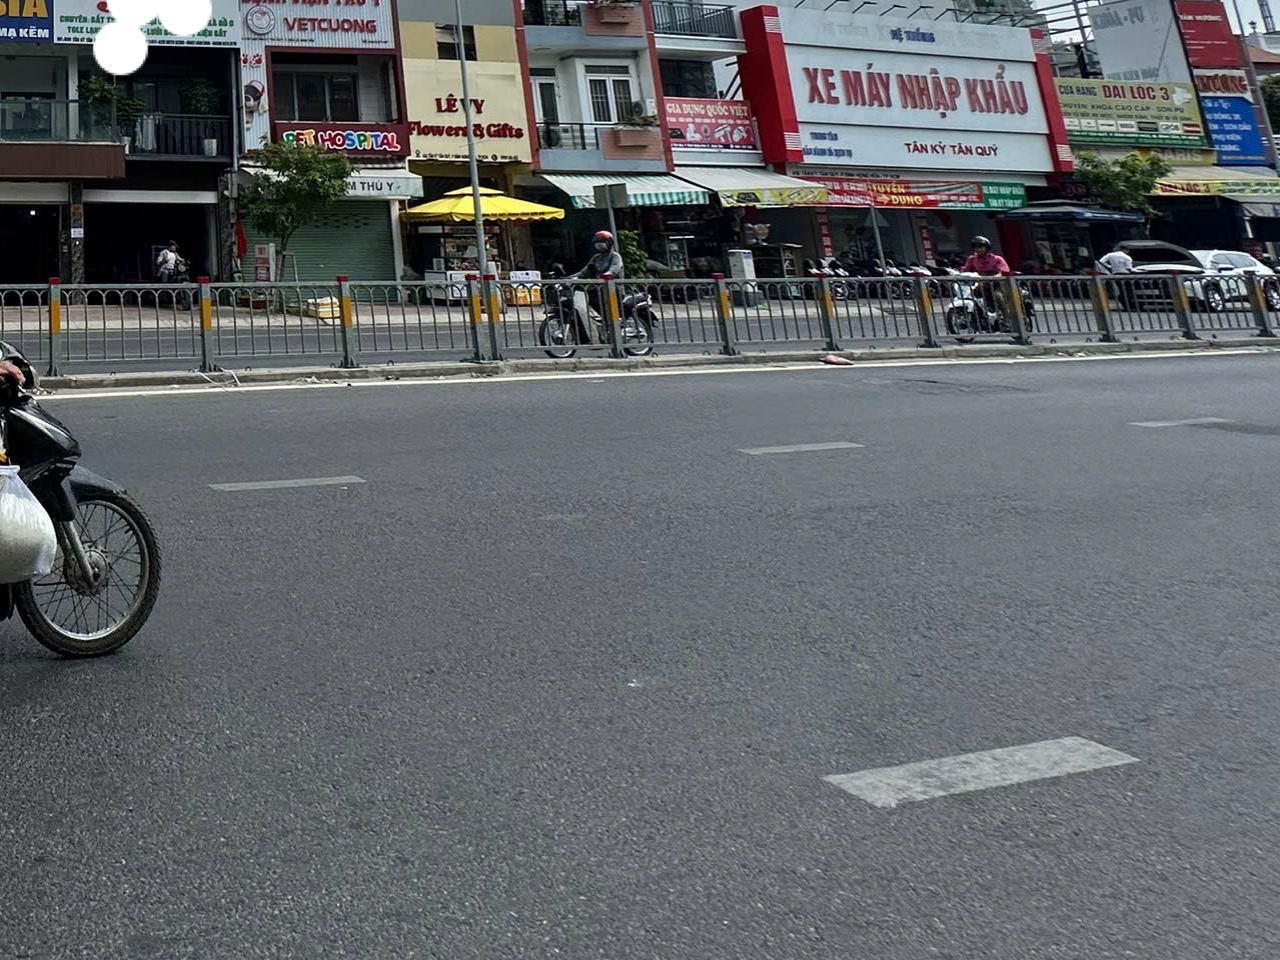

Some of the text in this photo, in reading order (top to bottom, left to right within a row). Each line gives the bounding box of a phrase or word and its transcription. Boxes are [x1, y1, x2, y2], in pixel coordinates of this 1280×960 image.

[19, 26, 50, 38] KẼM
[802, 62, 1029, 119] XE MÁY NHẬP KHẨU
[1160, 87, 1170, 101] 3
[435, 93, 458, 113] LÊ
[666, 103, 682, 114] GIA
[486, 122, 524, 139] Gifts
[283, 129, 401, 151] PET HOSPITAL
[904, 140, 928, 153] TÂN
[950, 142, 973, 155] TÂN
[360, 180, 394, 191] THÚ Y
